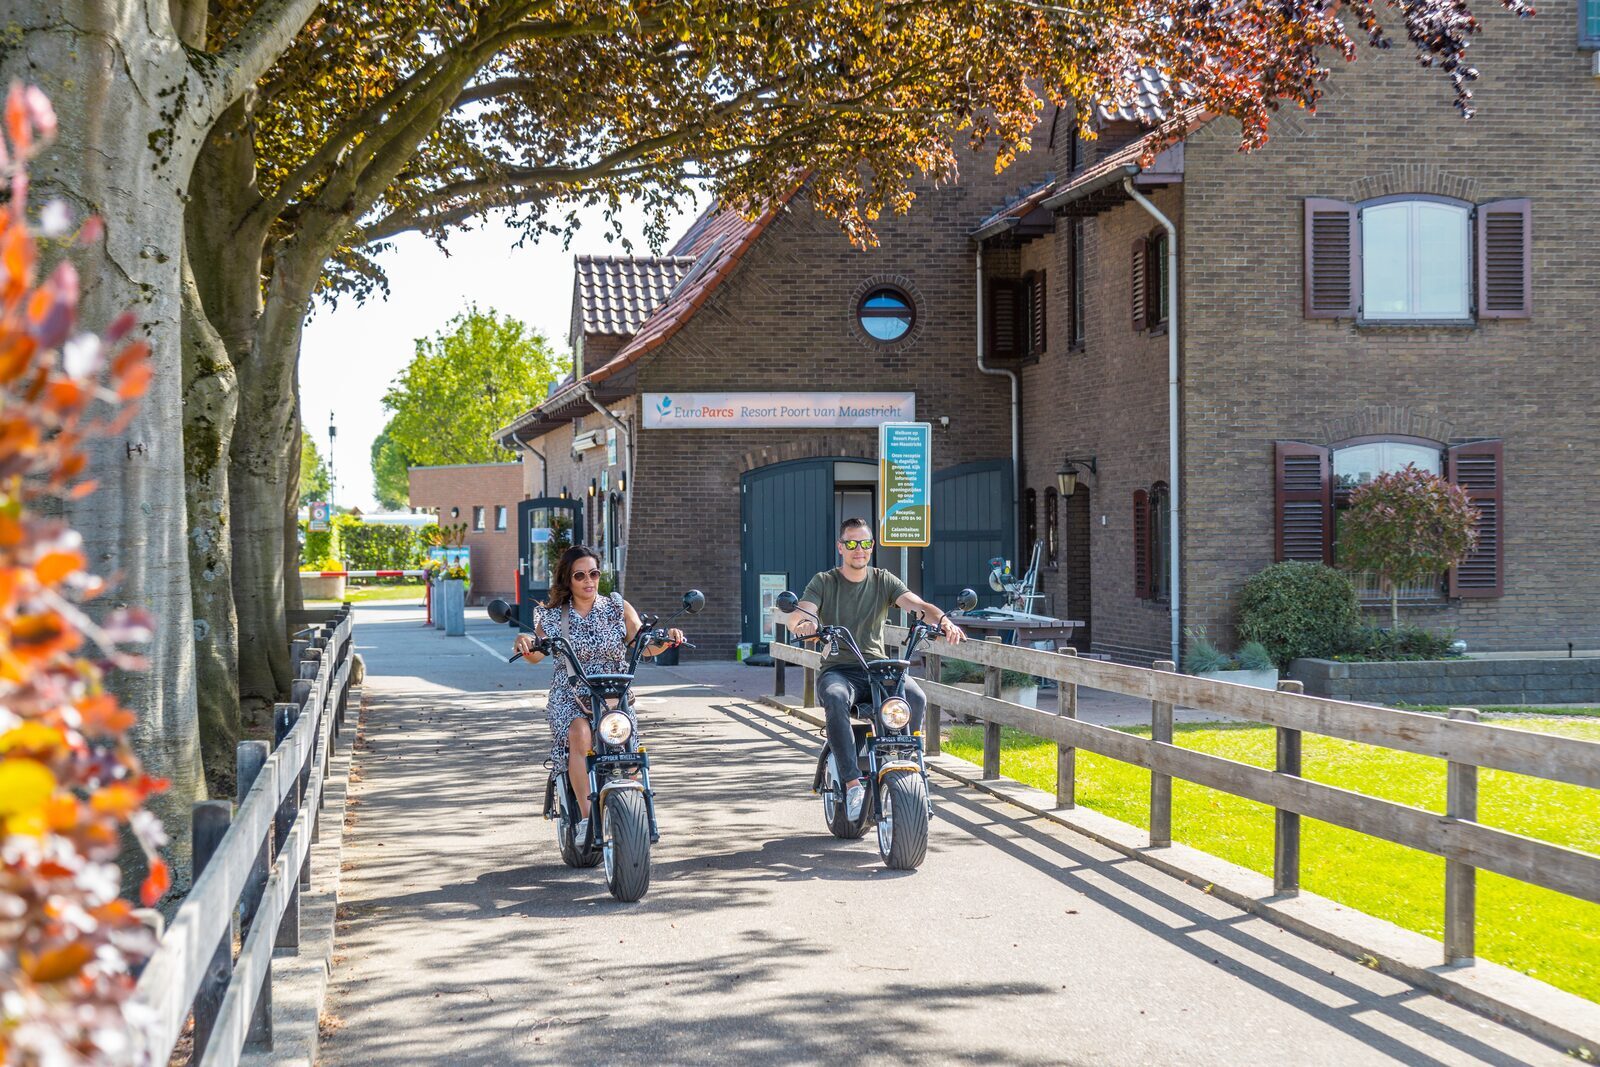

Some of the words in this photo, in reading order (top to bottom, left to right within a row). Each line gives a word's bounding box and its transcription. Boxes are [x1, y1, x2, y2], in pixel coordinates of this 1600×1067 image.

[674, 406, 734, 418] EuroParcs
[741, 406, 776, 417] Resort
[780, 406, 810, 416] Poort
[814, 408, 835, 416] van
[838, 406, 902, 416] Maastricht
